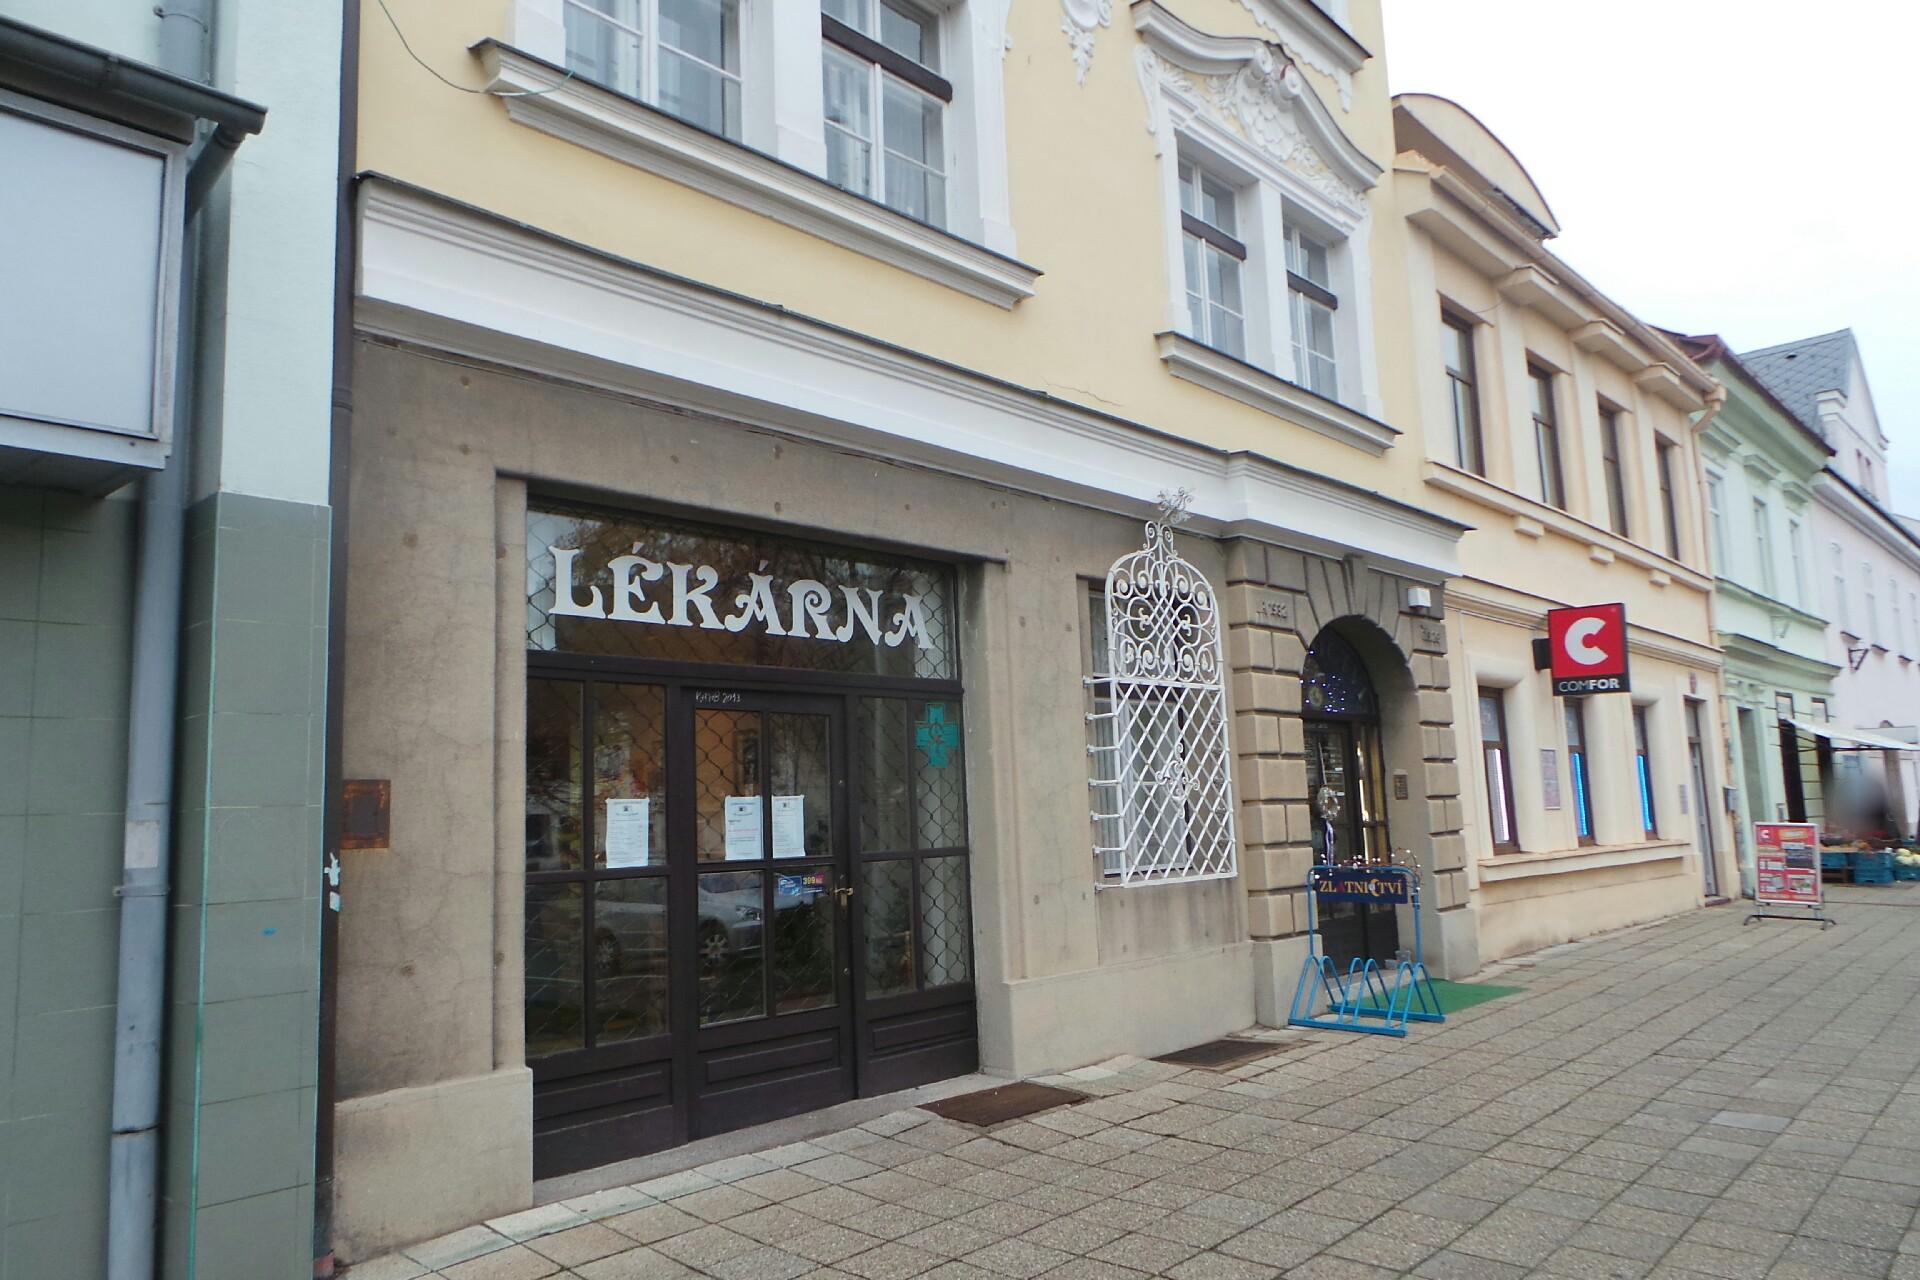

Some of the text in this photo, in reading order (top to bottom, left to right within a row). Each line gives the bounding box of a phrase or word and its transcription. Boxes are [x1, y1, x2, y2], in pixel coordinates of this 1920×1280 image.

[548, 542, 933, 649] LÉKÁRNA
[1564, 616, 1608, 666] C
[1558, 677, 1620, 692] COMFOR
